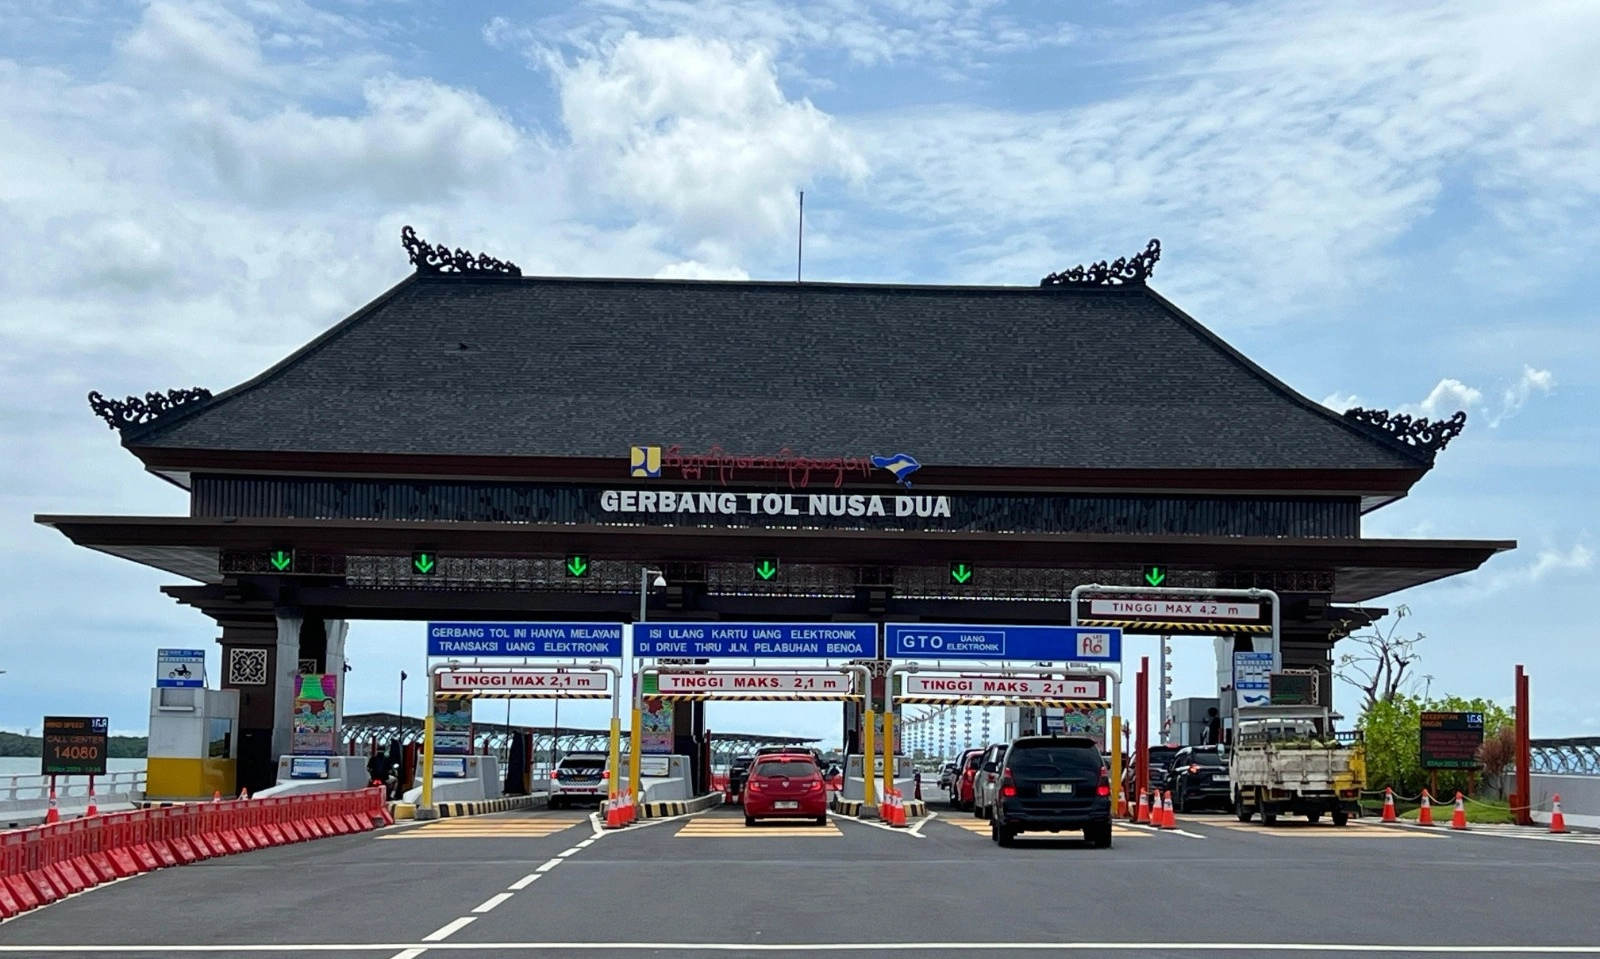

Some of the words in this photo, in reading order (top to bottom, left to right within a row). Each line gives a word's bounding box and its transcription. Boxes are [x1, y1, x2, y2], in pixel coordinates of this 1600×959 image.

[600, 490, 737, 516] GERBANG
[747, 493, 800, 517] TOL
[808, 494, 886, 518] NUSA
[894, 495, 952, 519] DUA
[1112, 602, 1158, 613] TINGGI
[1165, 604, 1192, 614] MAX
[1199, 605, 1218, 616] 4,2
[1227, 607, 1239, 615] m
[431, 627, 485, 639] GERBANG
[489, 628, 511, 639] TOL
[514, 628, 527, 639] INI
[531, 629, 566, 639] HANYA
[570, 629, 621, 640] MELAYANI
[650, 629, 662, 639] ISI
[668, 629, 704, 640] ULANG
[711, 629, 748, 640] KARTU
[752, 629, 782, 640] UANG
[791, 629, 857, 640] ELEKTRONIK
[960, 635, 986, 643] UANG
[439, 641, 498, 652] TRANSAKSI
[506, 641, 535, 652] UANG
[544, 641, 609, 653] ELEKTRONIK
[640, 642, 650, 653] DI
[656, 642, 687, 653] DRIVE
[695, 642, 722, 653] THRU
[728, 643, 750, 653] JLN.
[754, 643, 819, 653] PELABUHAN
[826, 643, 864, 653] BENOA
[902, 635, 944, 649] GTO
[947, 643, 1000, 652] ELEKTRONIK
[452, 675, 507, 687] TINGGI
[511, 675, 546, 687] MAX
[549, 676, 571, 688] 2,1
[577, 678, 591, 687] m
[671, 676, 724, 688] TINGGI
[734, 677, 783, 688] MAKS.
[794, 678, 815, 690] 2,1
[823, 680, 837, 688] m
[920, 680, 974, 691] TINGGI
[983, 681, 1033, 692] MAKS.
[1043, 683, 1064, 695] 2,1
[1073, 685, 1087, 694] m
[47, 735, 68, 743] CALL
[71, 735, 105, 744] CENTER
[54, 746, 98, 759] 14080
